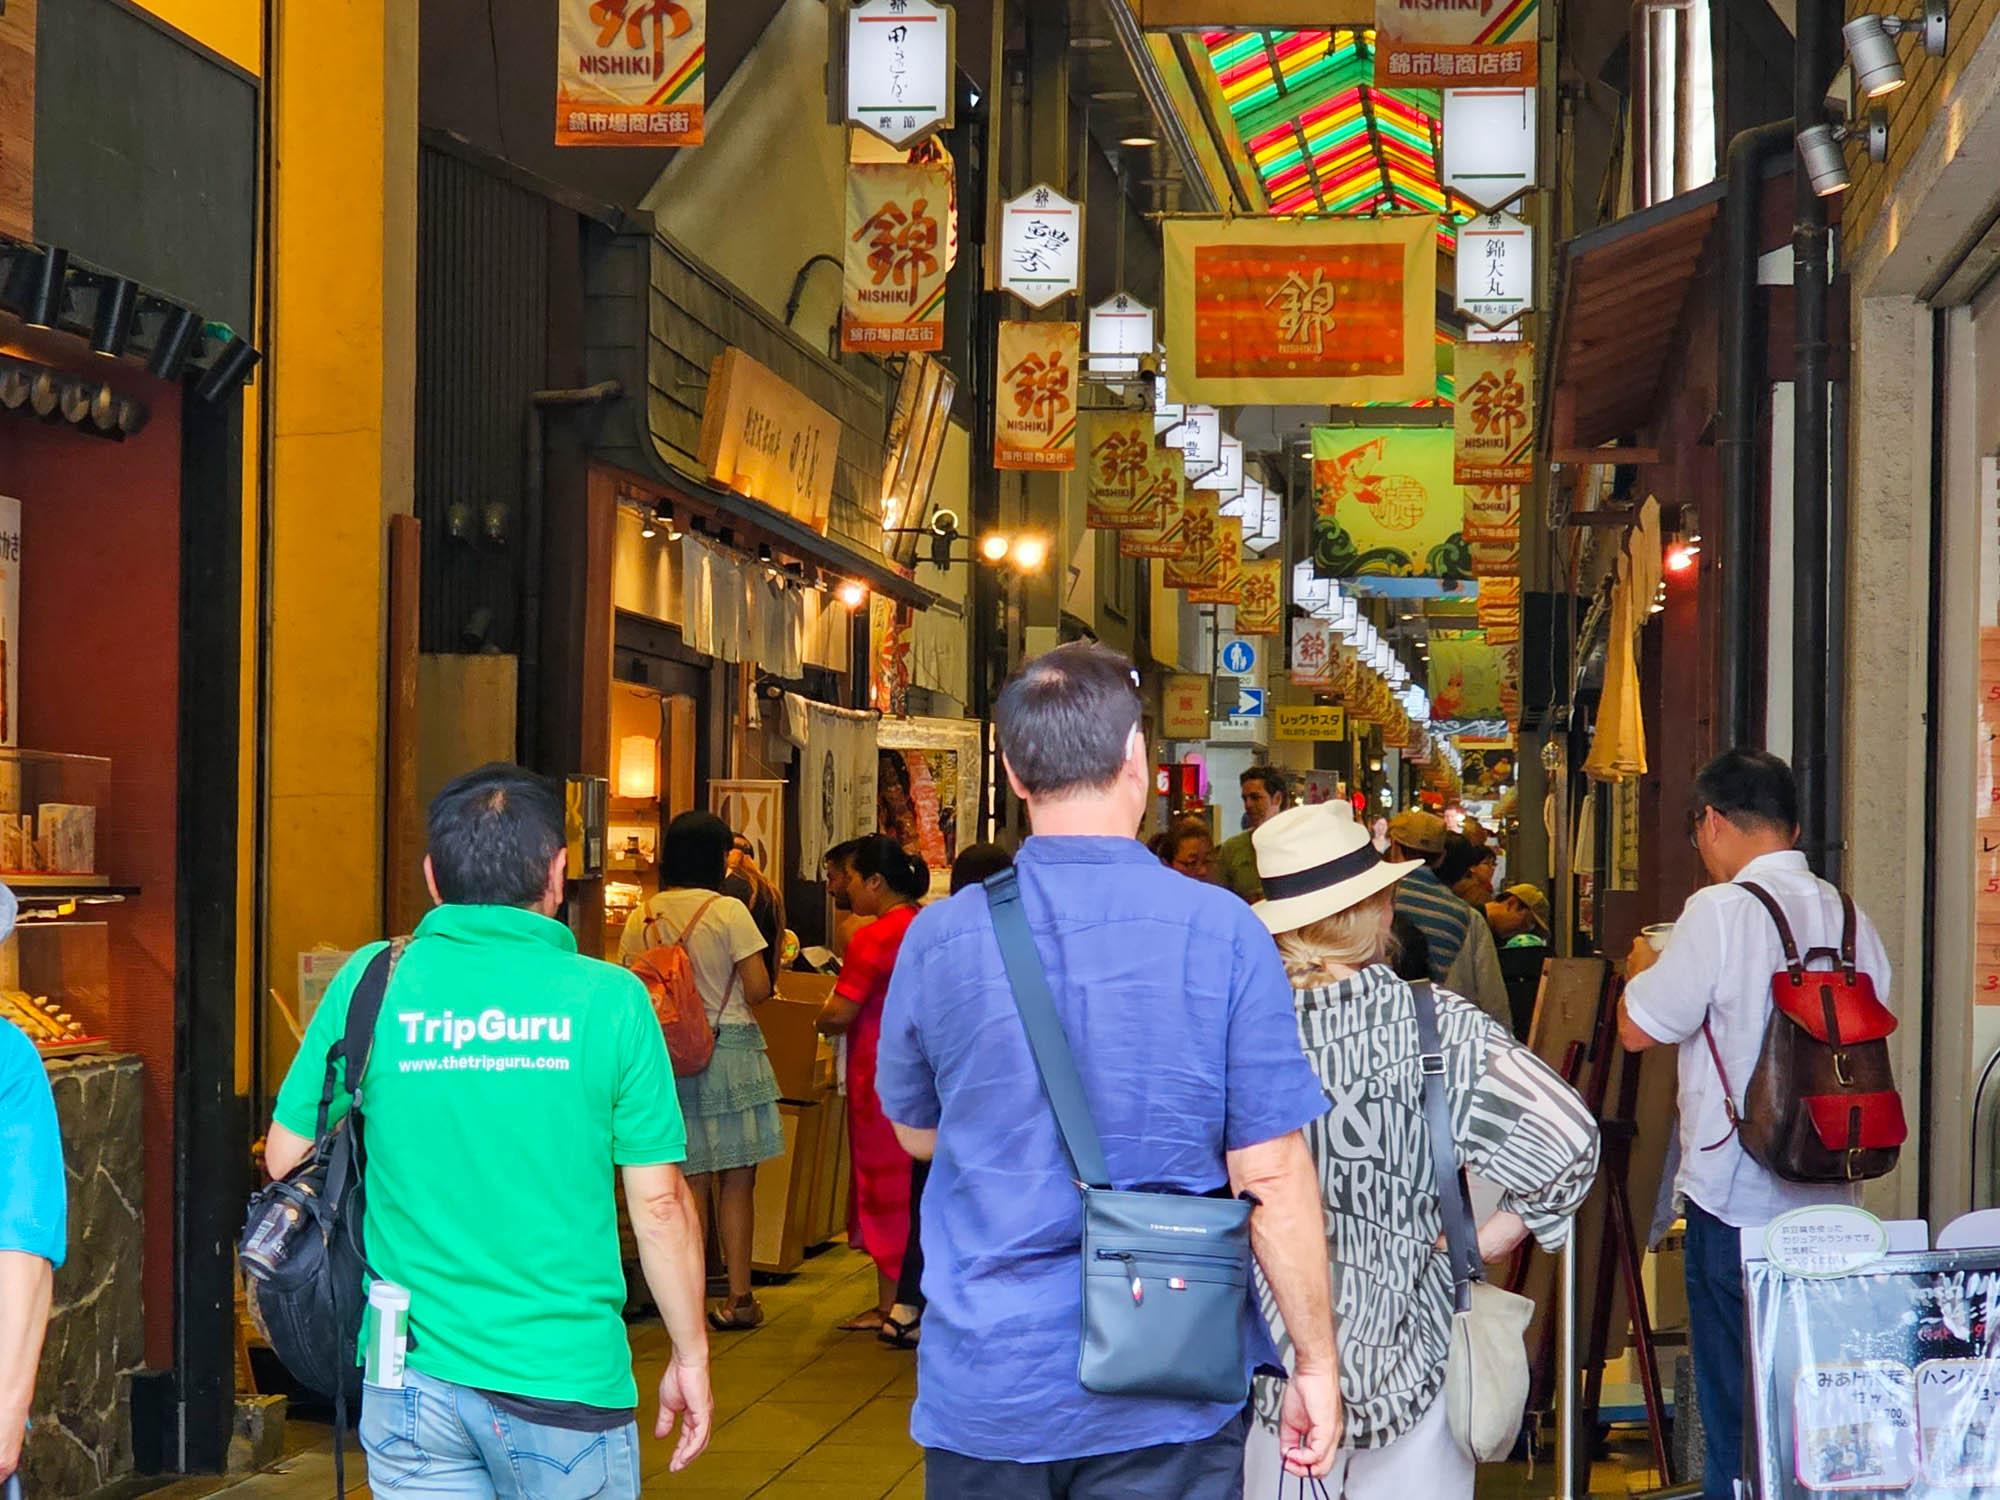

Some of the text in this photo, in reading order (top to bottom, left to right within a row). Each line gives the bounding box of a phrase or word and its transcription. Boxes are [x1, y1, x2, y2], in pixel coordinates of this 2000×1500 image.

[580, 55, 651, 76] NISHIKI
[1388, 53, 1522, 75] 錦市場商店街
[568, 110, 690, 134] 錦市場商店街
[852, 198, 938, 307] 錦
[1482, 238, 1505, 297] 錦大丸
[857, 289, 909, 304] NISHIKI
[1265, 268, 1336, 356] 錦
[849, 326, 935, 342] 錦市場商店街
[1003, 350, 1070, 435] 錦
[1458, 367, 1528, 450] 錦
[1006, 418, 1049, 433] NISHIKI
[1465, 437, 1504, 449] NISHIKI
[398, 1007, 572, 1050] TripGuru
[398, 1054, 570, 1073] www.thetripguru.com
